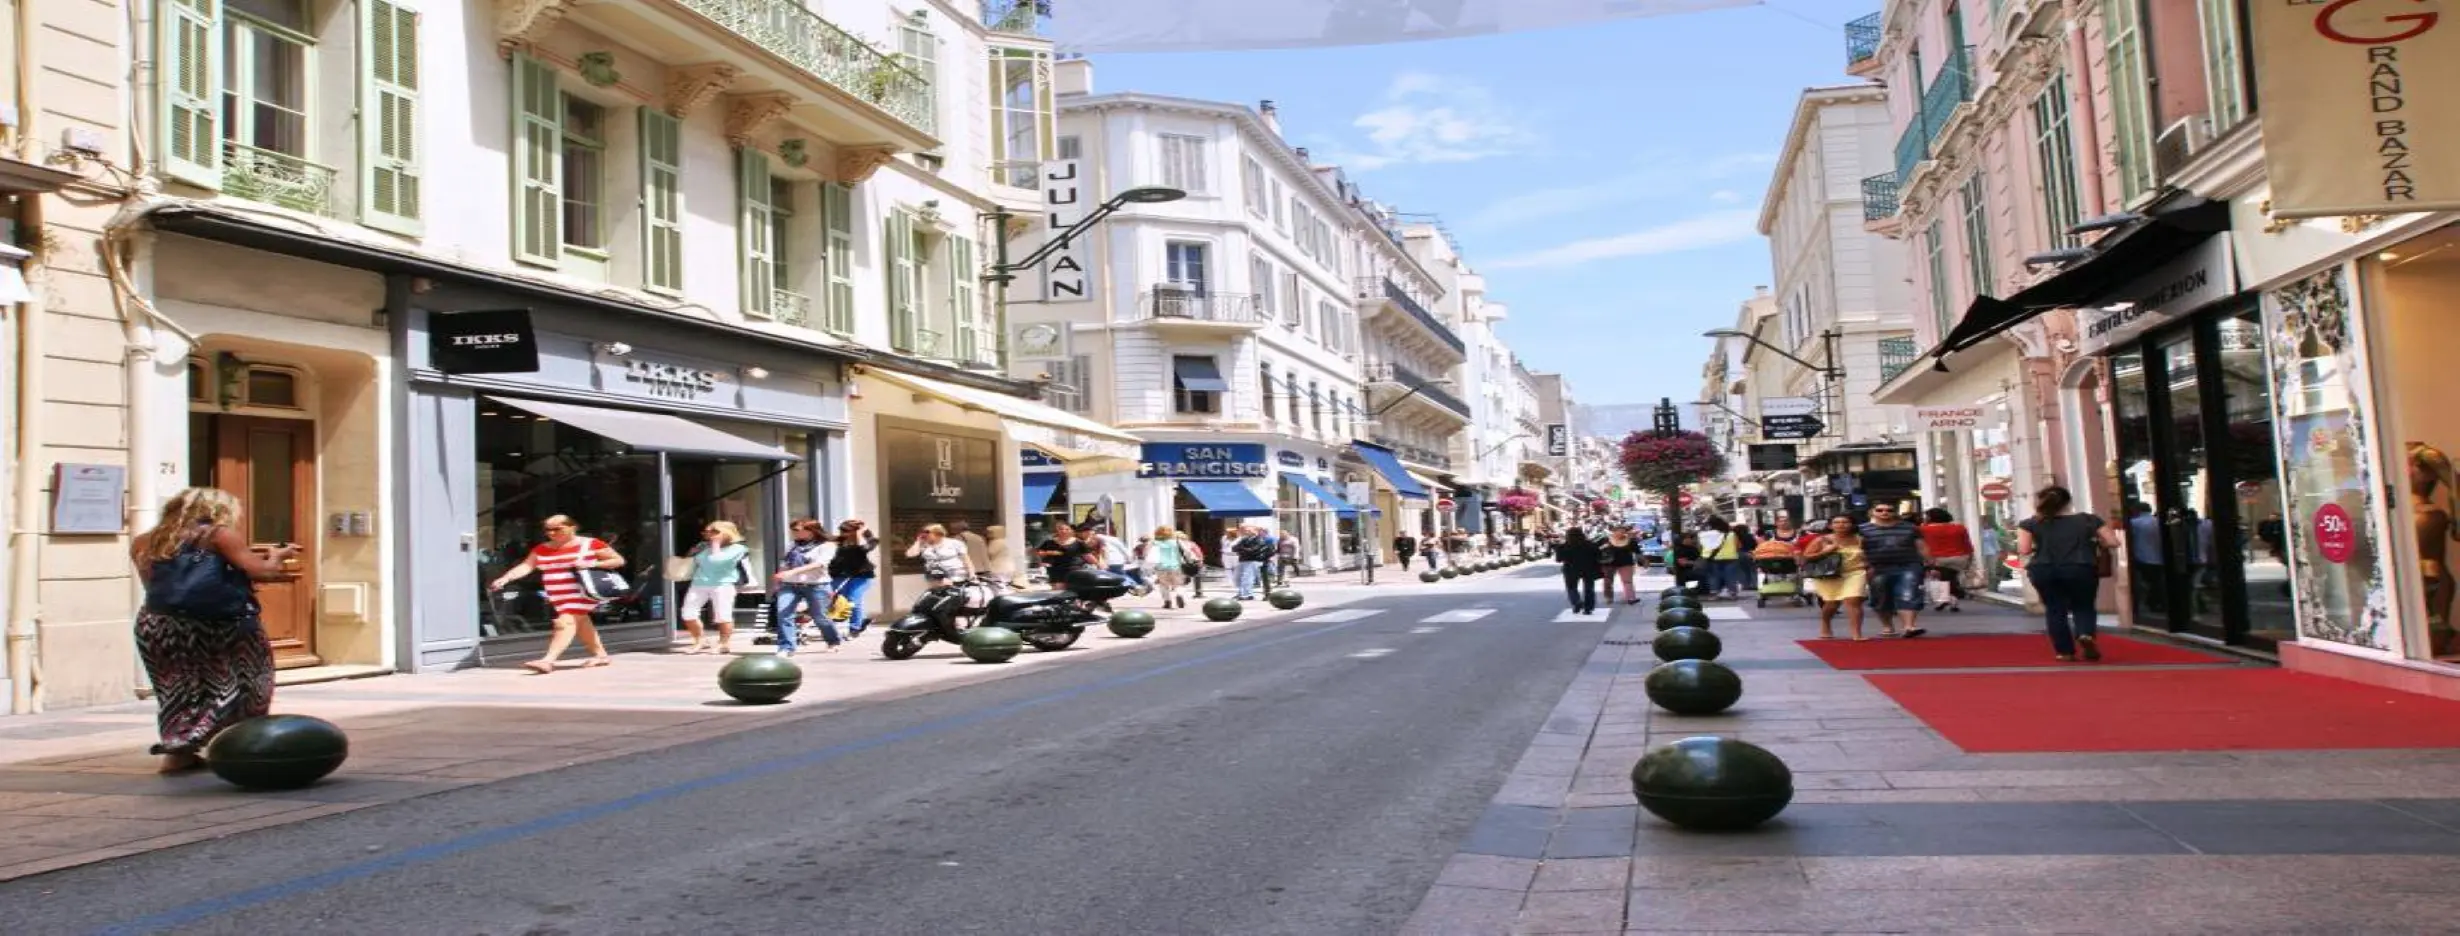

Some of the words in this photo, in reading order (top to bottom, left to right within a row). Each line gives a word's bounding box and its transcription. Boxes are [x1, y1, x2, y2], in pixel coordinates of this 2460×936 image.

[2375, 119, 2415, 201] BAZAR
[451, 333, 519, 346] IKKS
[627, 359, 714, 388] IKKS
[1918, 408, 1985, 418] FRANCE
[1930, 418, 1977, 428] ARNO
[1184, 447, 1233, 460] SAN
